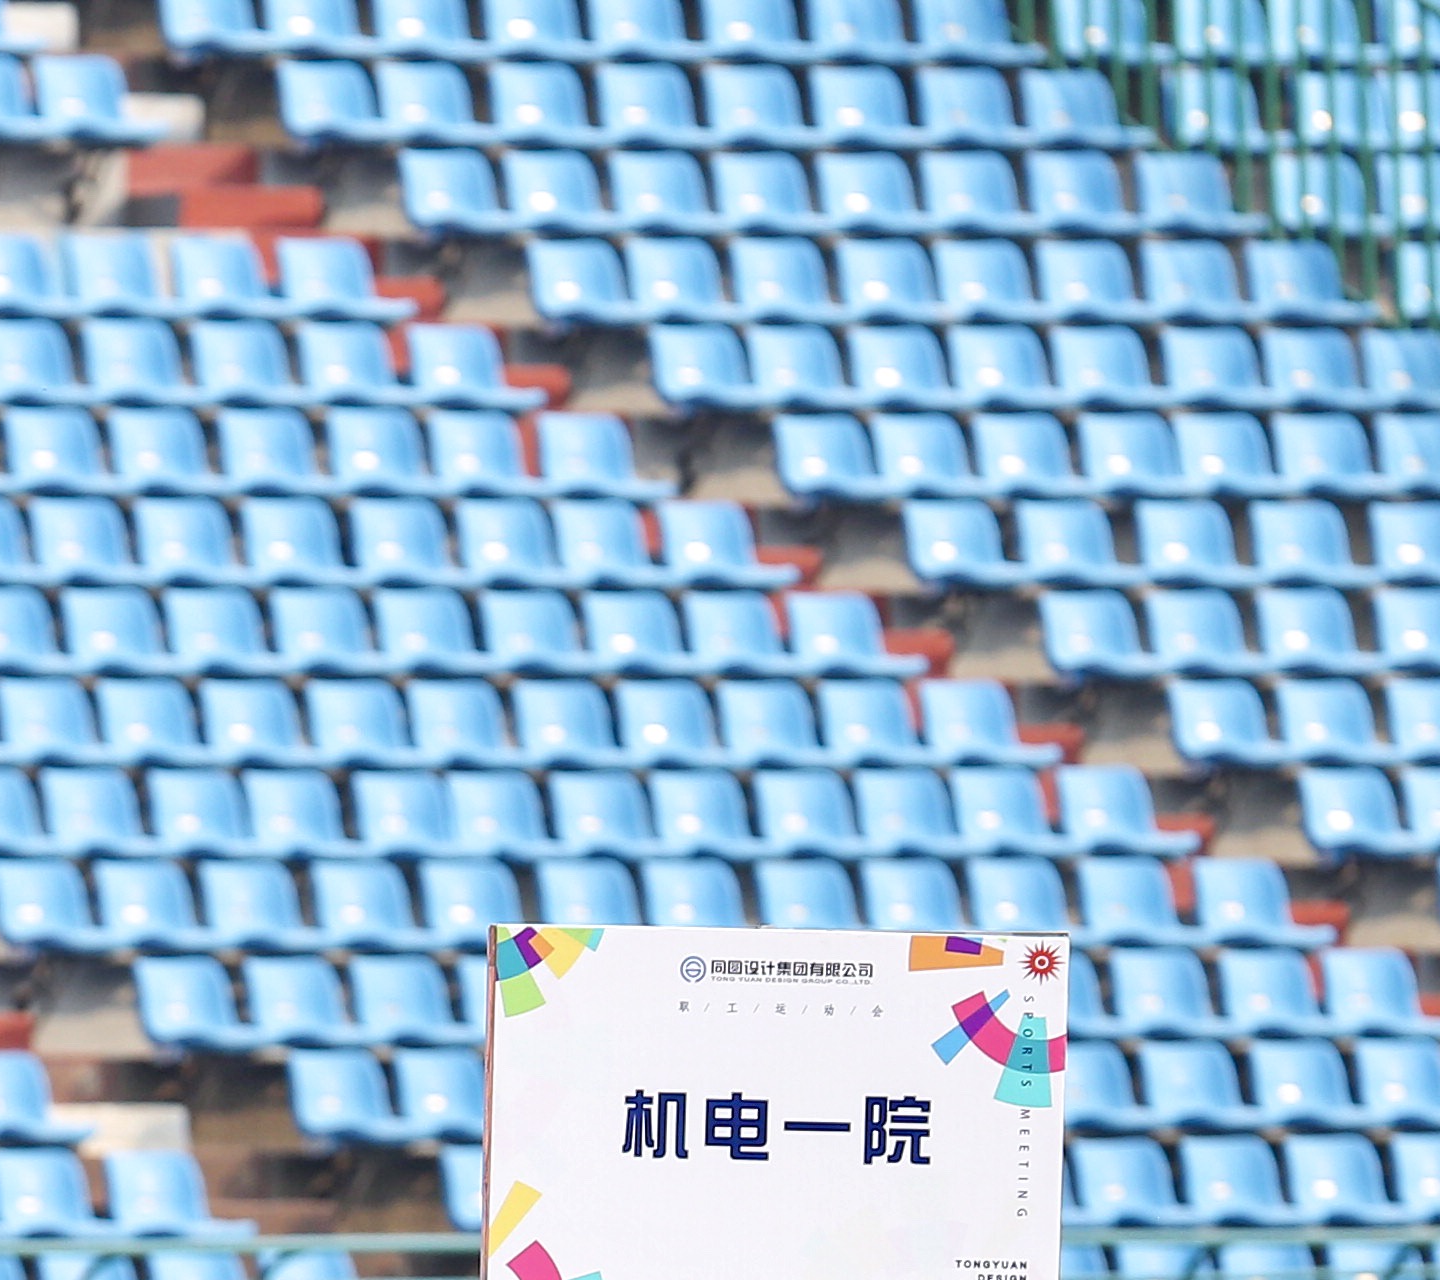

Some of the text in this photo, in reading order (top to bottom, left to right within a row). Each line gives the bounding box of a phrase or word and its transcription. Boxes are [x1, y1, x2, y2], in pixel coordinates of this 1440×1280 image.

[710, 959, 874, 978] 同圆设计集团有限公司
[622, 1089, 930, 1165] 机电一院
[1017, 995, 1034, 1217] SPORTS MEETING
[955, 1259, 1027, 1270] TONGYUAN
